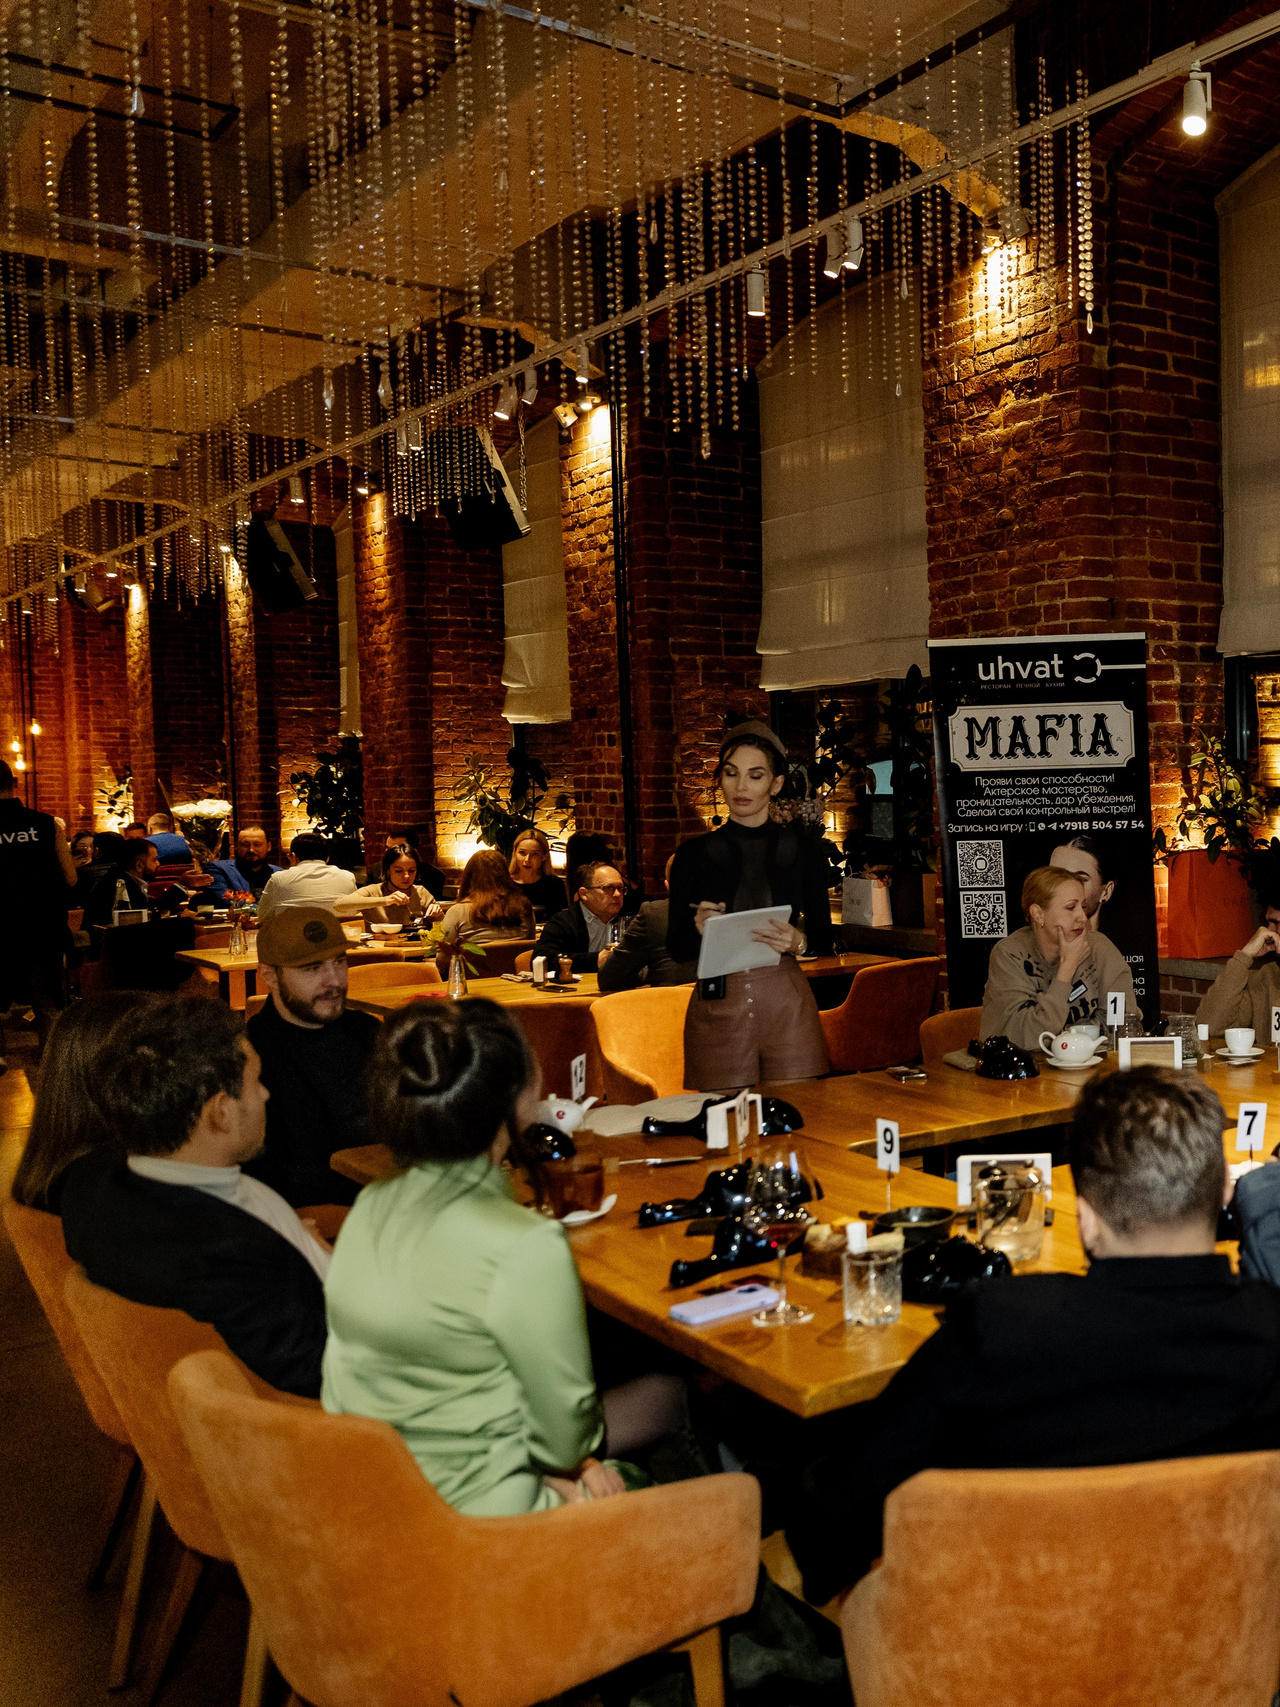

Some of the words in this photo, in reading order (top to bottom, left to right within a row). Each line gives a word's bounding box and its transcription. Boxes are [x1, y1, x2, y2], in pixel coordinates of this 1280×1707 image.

[978, 653, 1064, 681] uhvat
[963, 712, 1119, 760] MAFIA
[975, 776, 1013, 788] Прояви
[1014, 777, 1040, 785] свои
[1041, 773, 1115, 785] способности!
[983, 786, 1040, 798] Актерское
[1041, 785, 1108, 796] мастерство,
[956, 797, 1054, 809] проницательность,
[1055, 796, 1075, 806] дар
[957, 807, 997, 817] Сделай
[998, 806, 1024, 816] свой
[1025, 804, 1090, 817] контрольный
[1092, 803, 1136, 815] выстрел!
[0, 827, 39, 844] vat
[947, 823, 984, 833] Запись
[985, 824, 999, 832] на
[1059, 820, 1090, 831] +7918
[1092, 820, 1113, 830] 504
[1115, 820, 1129, 829] 57
[1131, 820, 1145, 829] 54
[1110, 996, 1118, 1015] 1
[1274, 1011, 1280, 1031] 3
[1244, 1110, 1258, 1136] 7
[883, 1127, 894, 1154] 9
